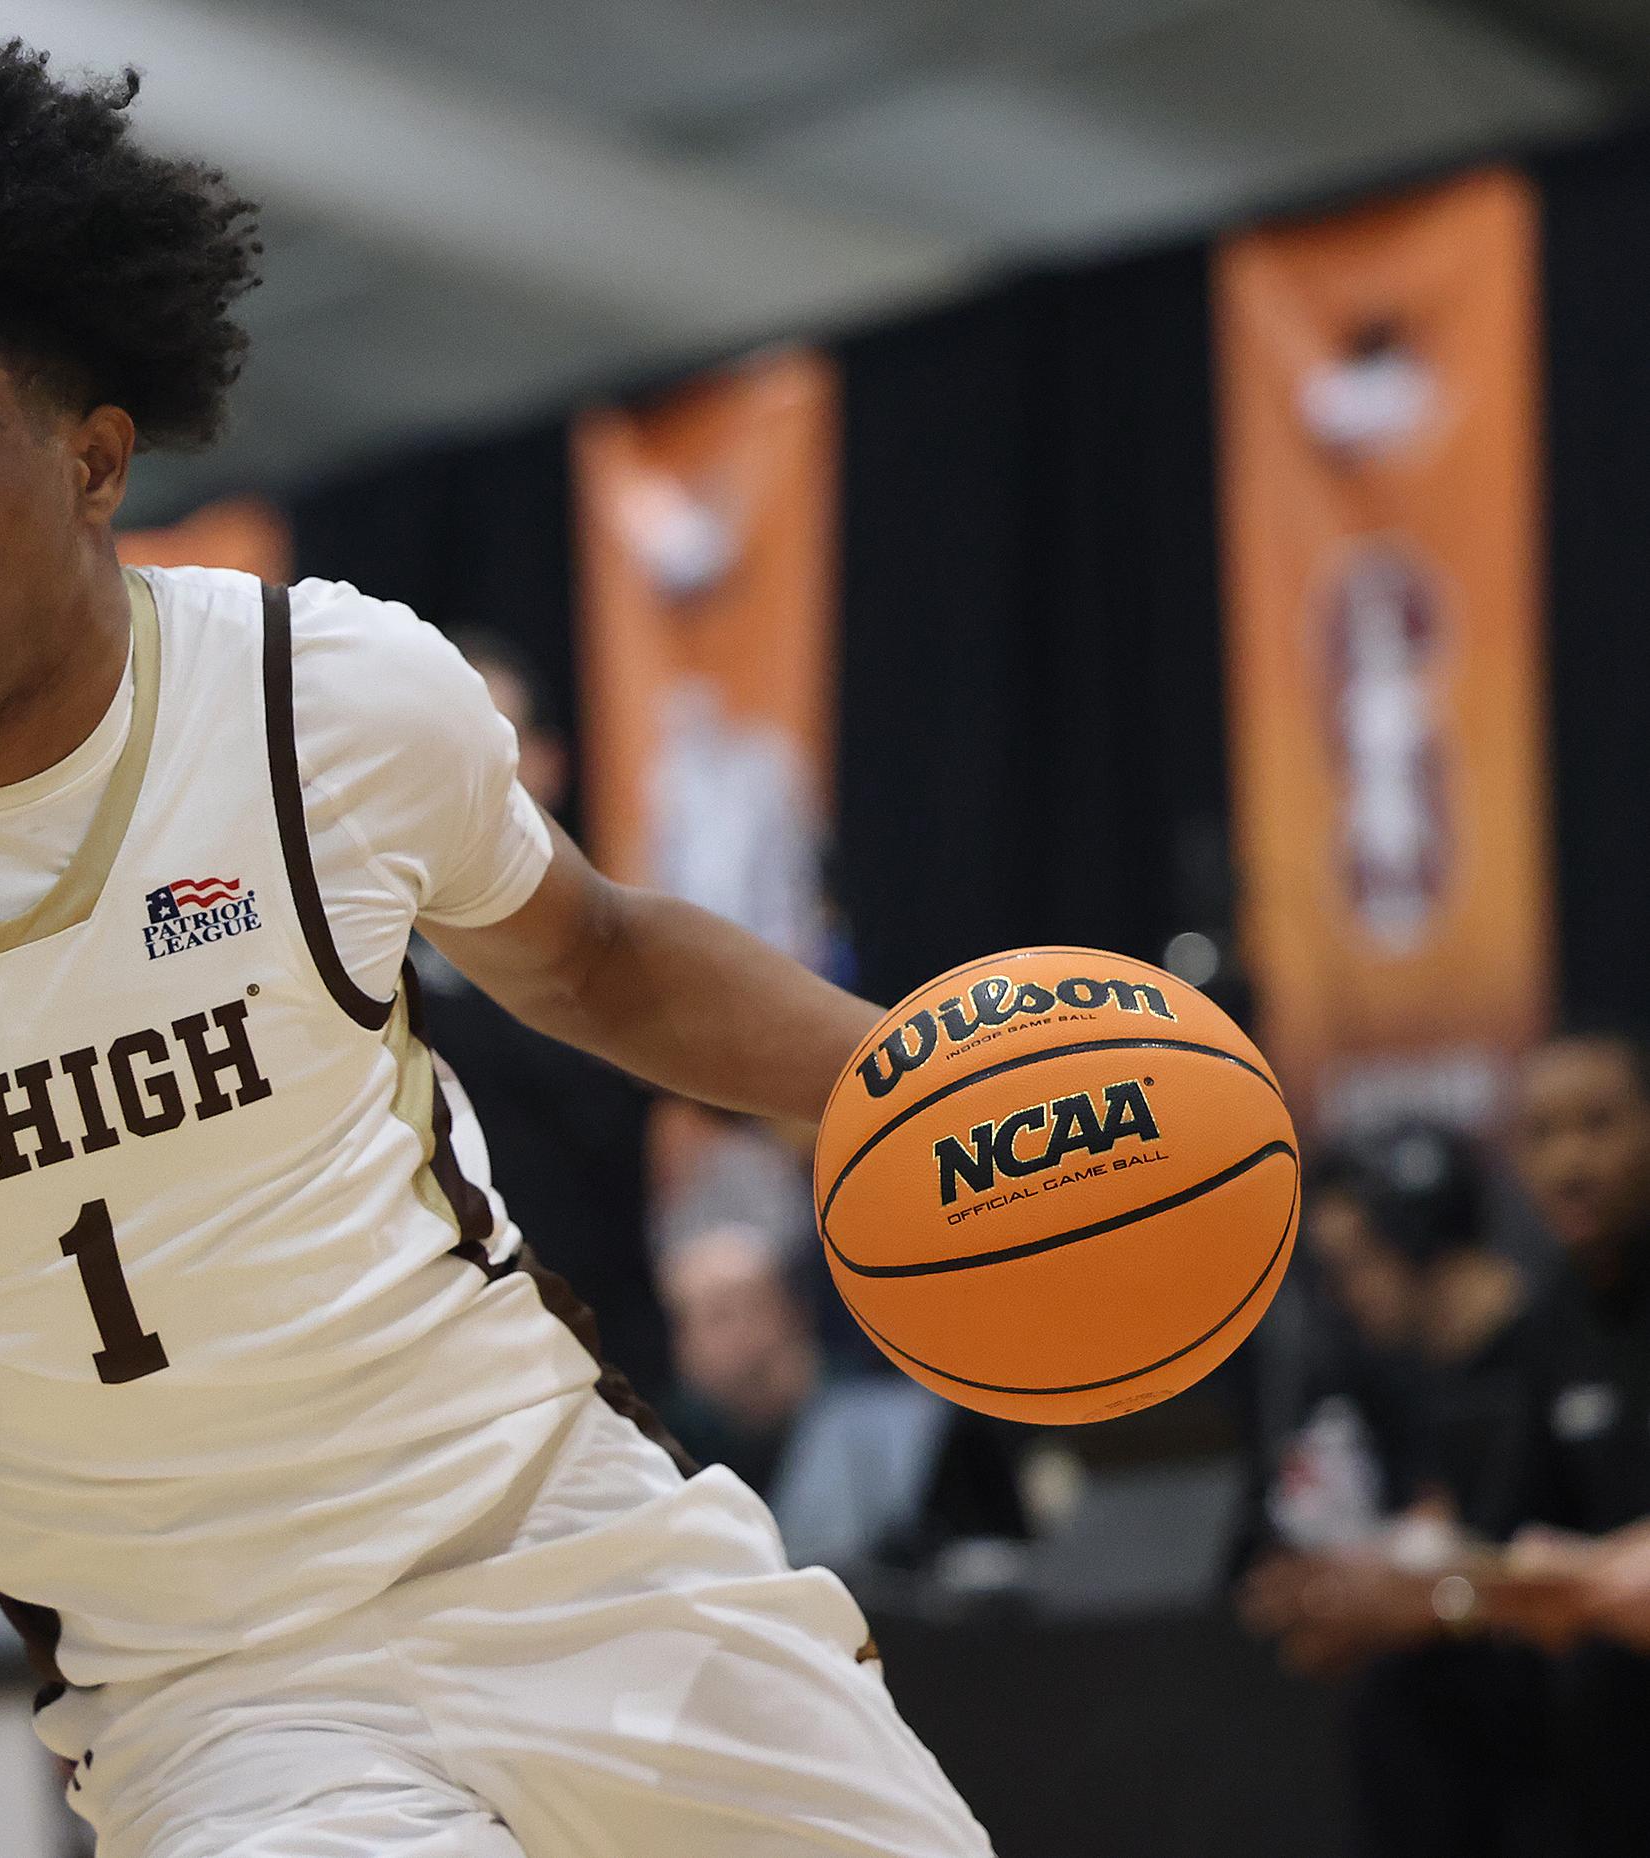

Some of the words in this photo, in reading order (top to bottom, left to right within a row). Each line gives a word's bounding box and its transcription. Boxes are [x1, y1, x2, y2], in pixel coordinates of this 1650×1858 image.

[142, 897, 256, 943] PATRIOT
[145, 913, 262, 960] LEAGUE
[855, 975, 1178, 1098] Wilson
[946, 1031, 1002, 1060] INDOOR
[1008, 1018, 1052, 1033] GAME
[1058, 1013, 1098, 1022] BALL
[933, 1078, 1161, 1207] NCAA
[947, 1188, 1039, 1226] OFFICIAL
[1043, 1164, 1107, 1191] GAME
[1113, 1150, 1169, 1171] BALL
[58, 1197, 170, 1384] 1
